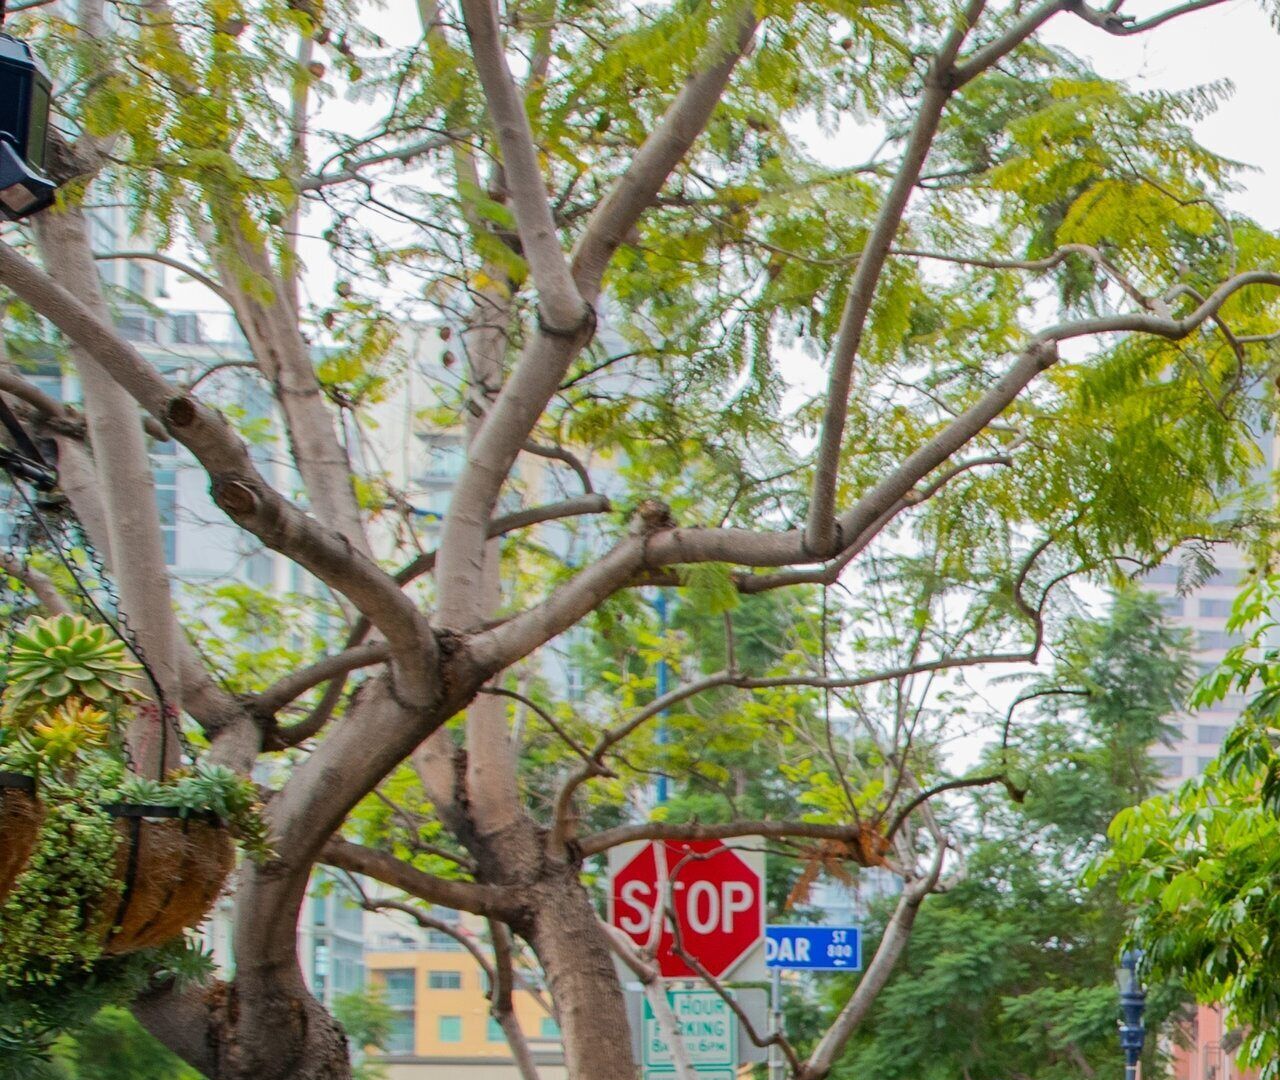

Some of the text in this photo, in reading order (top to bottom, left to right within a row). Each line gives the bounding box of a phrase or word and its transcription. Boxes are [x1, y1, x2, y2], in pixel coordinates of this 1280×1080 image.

[764, 930, 847, 962] DAR ST
[680, 998, 724, 1015] HOUR
[654, 1020, 725, 1037] PRKING
